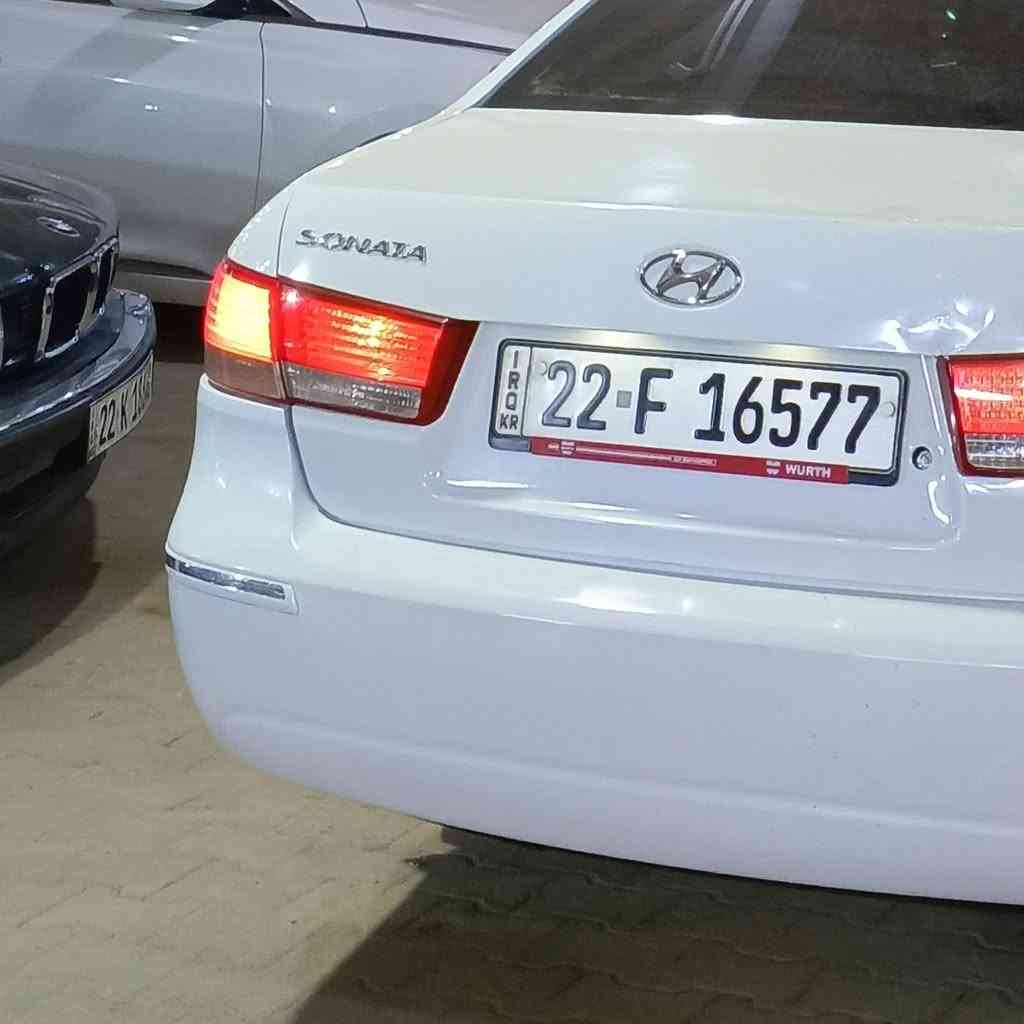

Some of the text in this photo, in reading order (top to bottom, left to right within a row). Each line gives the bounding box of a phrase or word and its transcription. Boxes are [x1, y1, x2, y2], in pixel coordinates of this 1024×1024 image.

[296, 229, 427, 263] SONATA
[499, 413, 520, 431] KR
[541, 360, 881, 454] 22 F 16577
